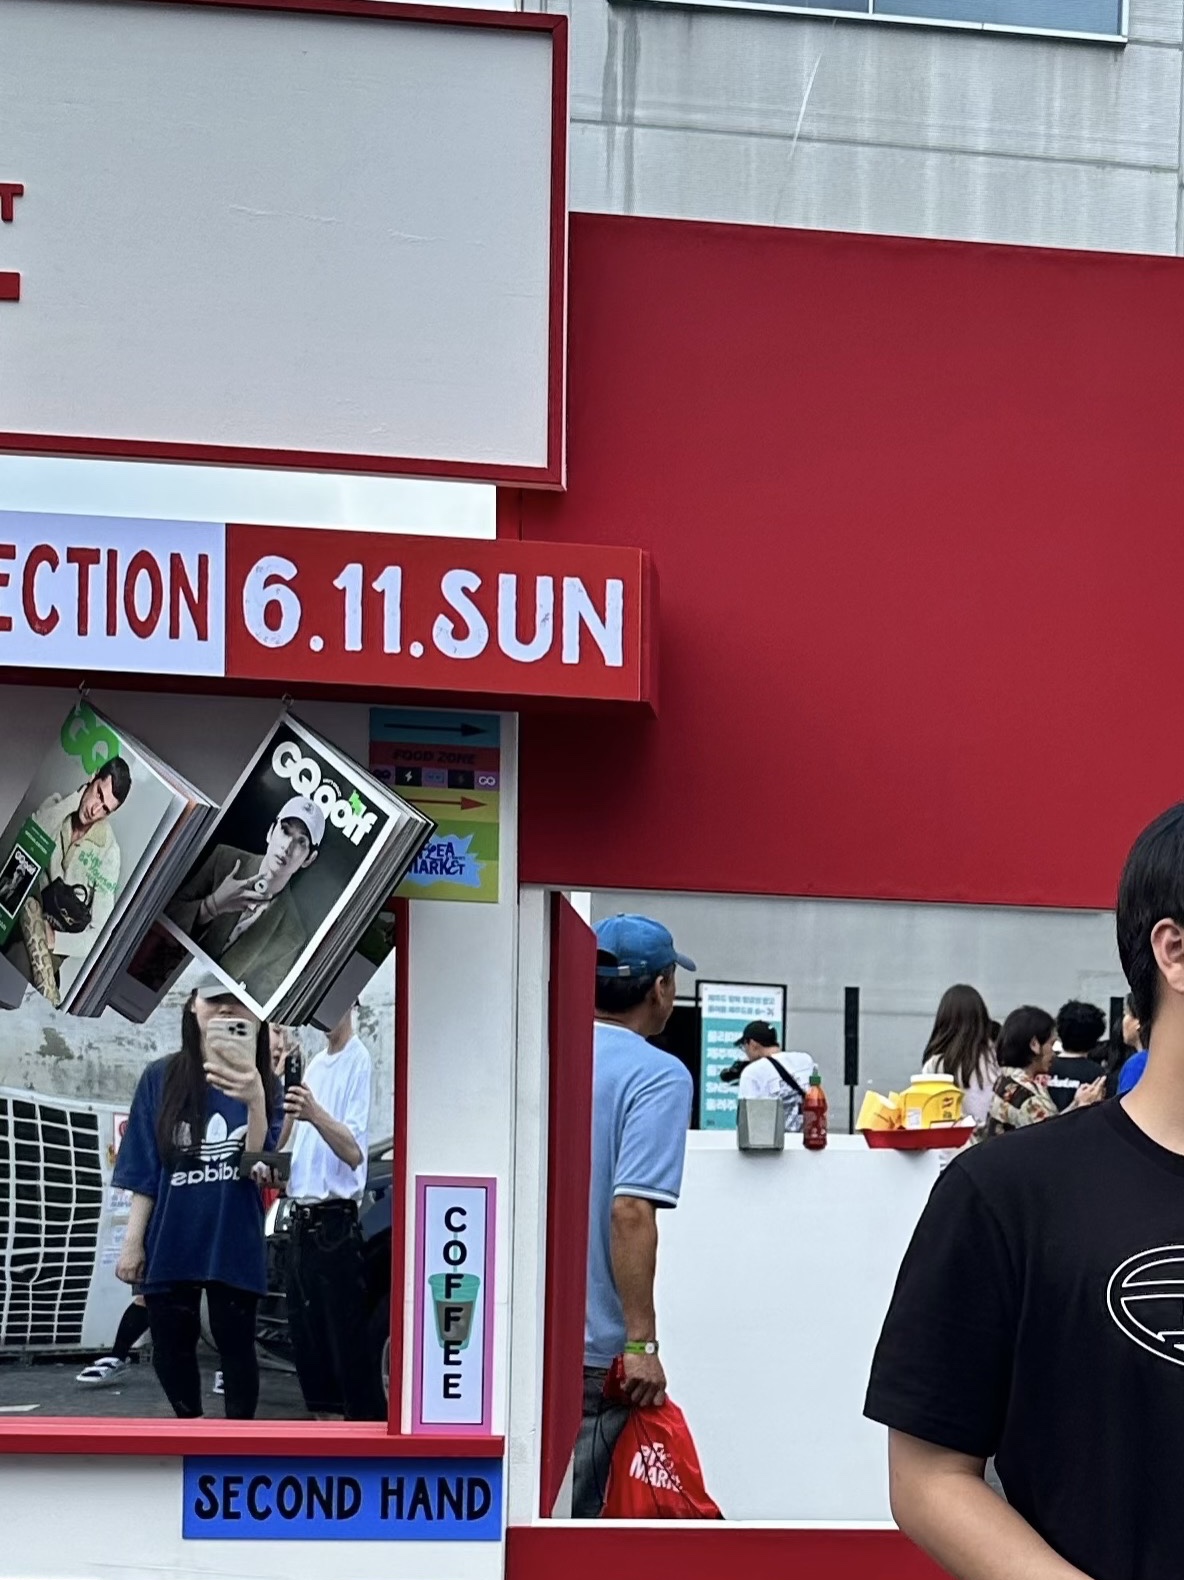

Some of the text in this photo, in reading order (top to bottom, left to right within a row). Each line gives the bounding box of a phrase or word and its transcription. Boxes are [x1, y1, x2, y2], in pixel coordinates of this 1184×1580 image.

[392, 748, 477, 765] FOOD ZONE
[442, 1206, 467, 1399] COFFEE
[194, 1474, 492, 1521] SECOND HAND
